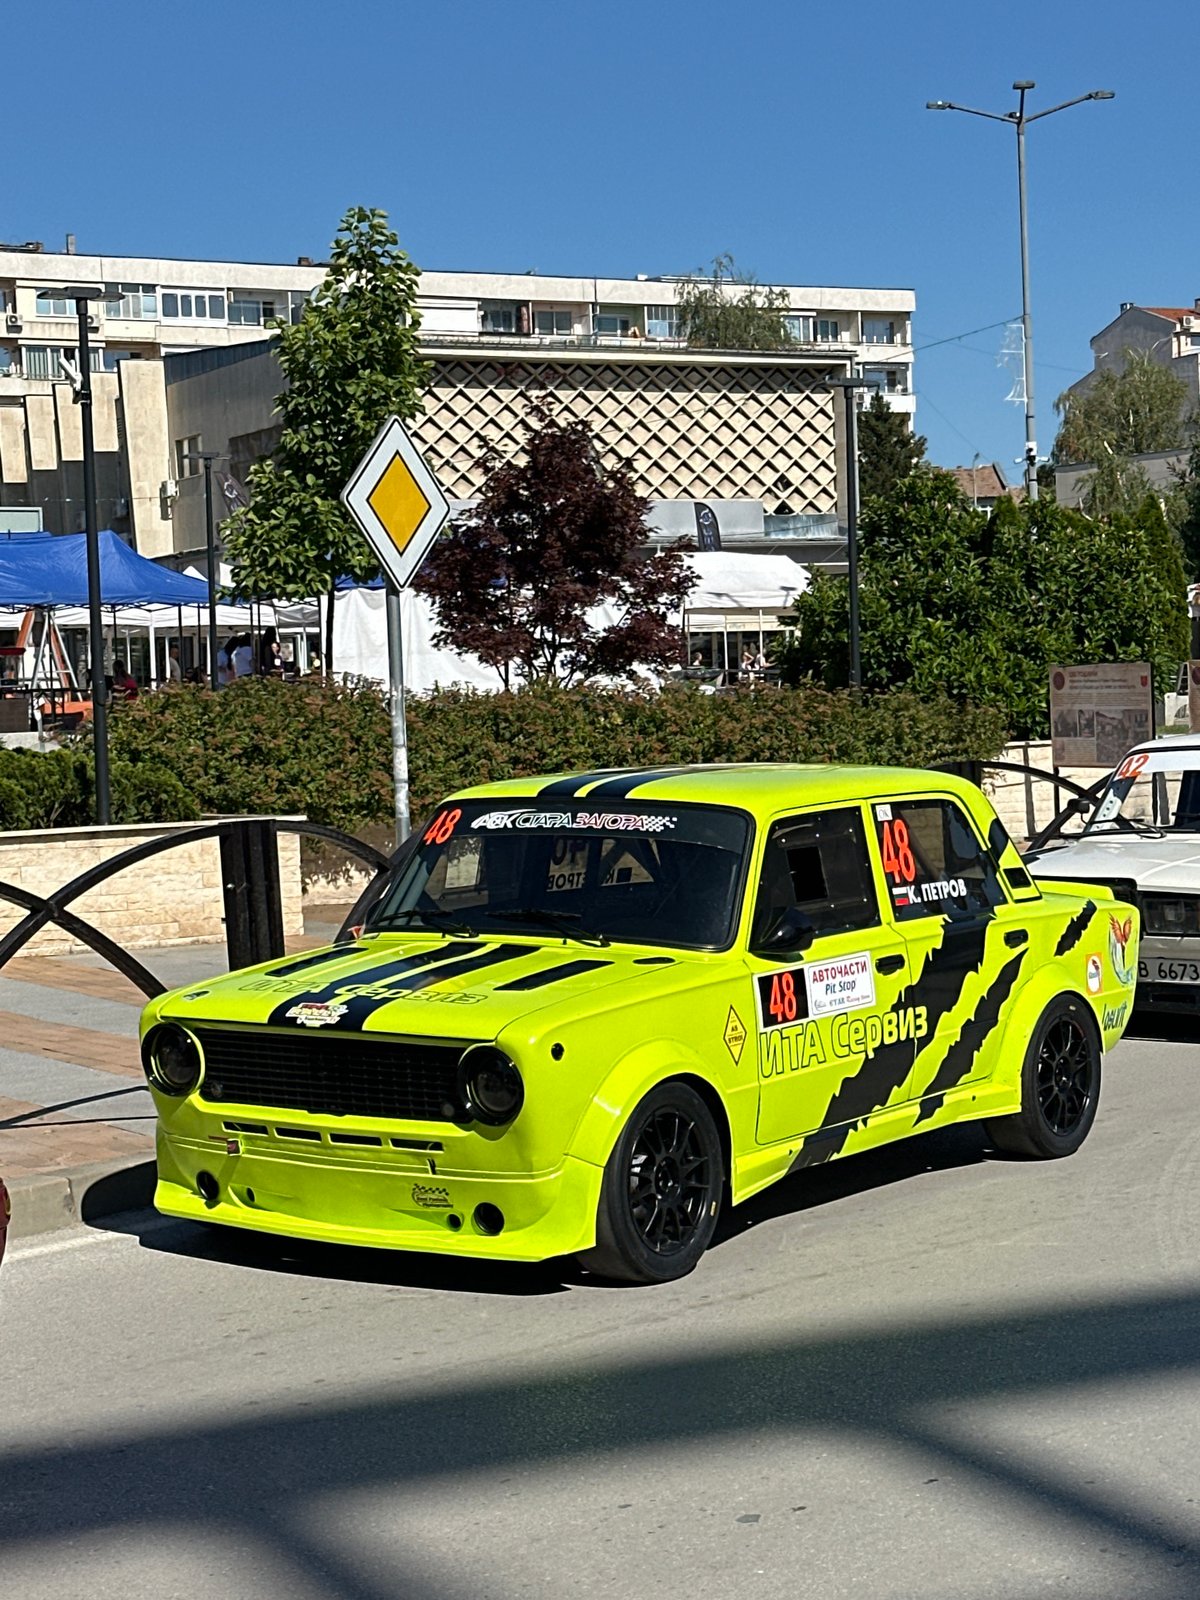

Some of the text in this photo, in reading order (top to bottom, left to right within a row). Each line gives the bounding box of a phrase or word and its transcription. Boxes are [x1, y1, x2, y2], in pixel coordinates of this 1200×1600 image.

[1117, 754, 1150, 779] 42
[423, 809, 462, 845] 48
[515, 813, 572, 828] СТАРА
[573, 813, 647, 830] ЗАГОРА
[883, 818, 916, 883] 48
[907, 879, 967, 904] К. ПЕТРОВ
[812, 960, 868, 984] АВТОЧАСТИ
[1158, 962, 1200, 980] 6673
[770, 972, 797, 1023] 48
[825, 979, 856, 995] Pit Stop
[759, 1006, 928, 1078] ИТА Сервиз
